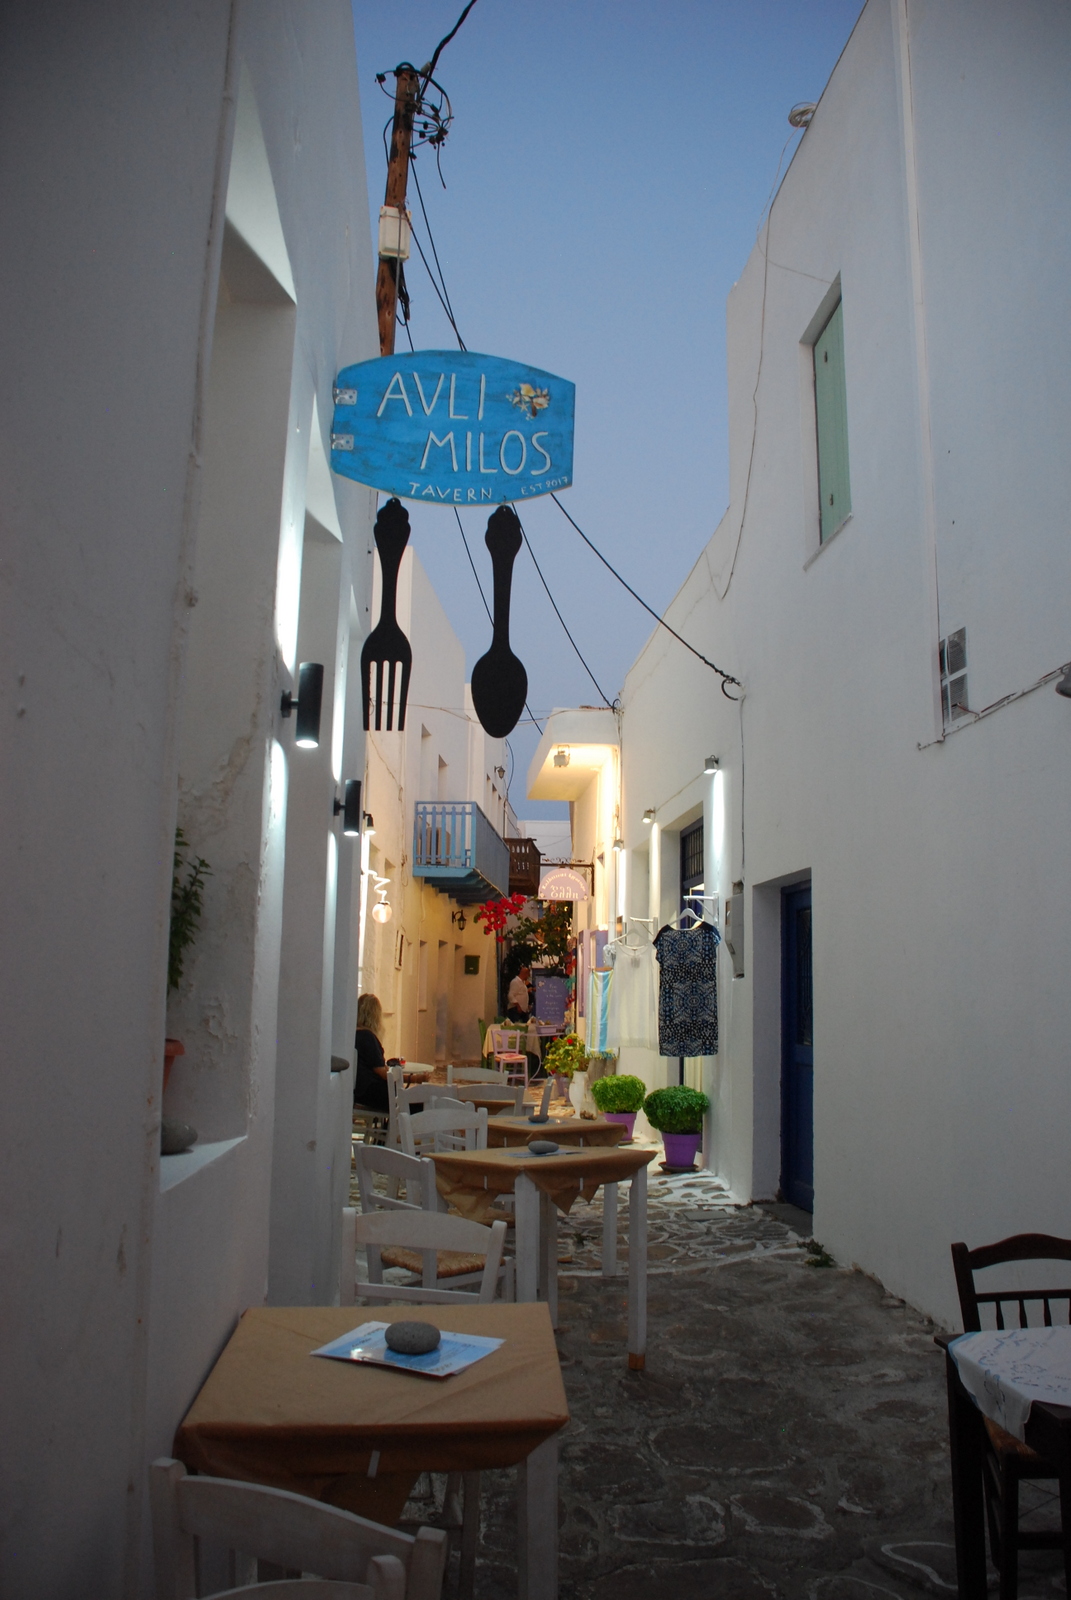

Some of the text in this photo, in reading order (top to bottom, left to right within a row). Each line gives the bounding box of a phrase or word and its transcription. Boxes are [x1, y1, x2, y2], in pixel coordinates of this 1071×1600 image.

[377, 372, 486, 420] AVLI
[420, 430, 552, 475] MILOS
[409, 482, 492, 501] TAVERN
